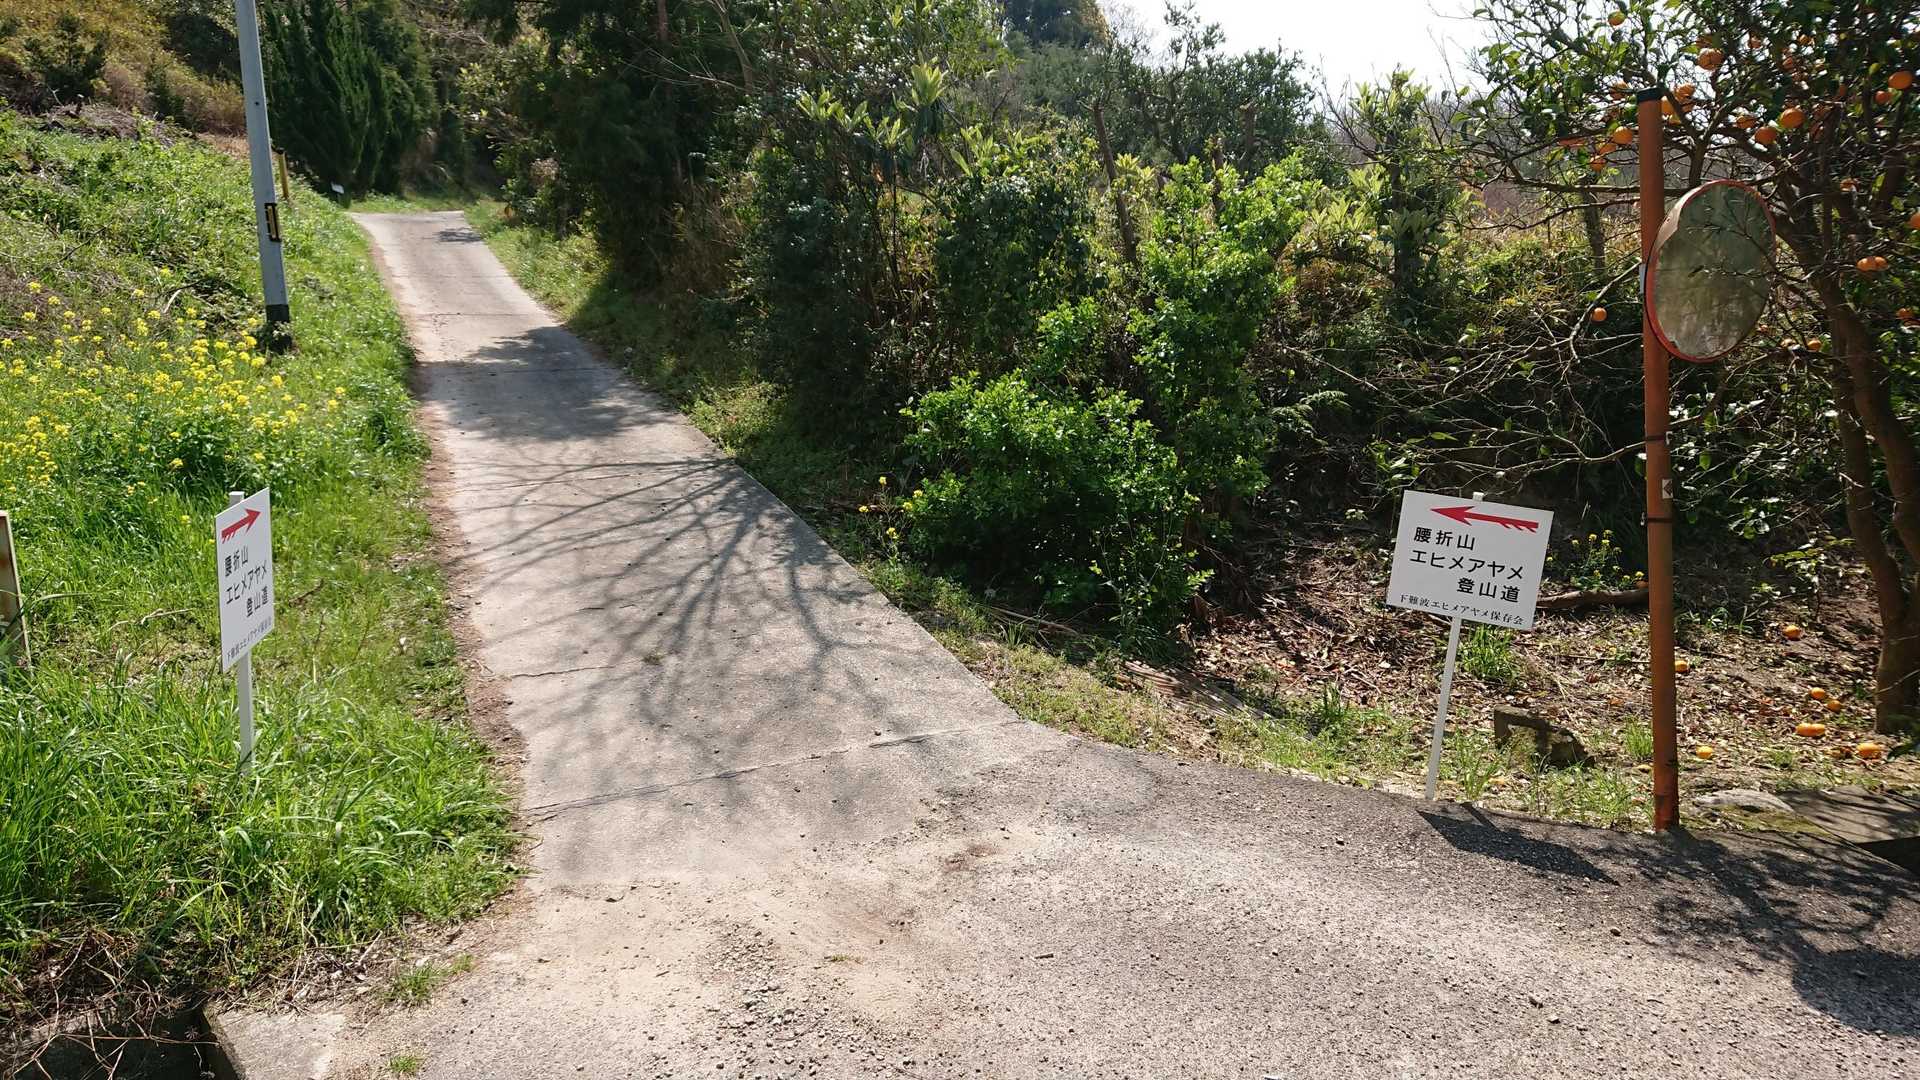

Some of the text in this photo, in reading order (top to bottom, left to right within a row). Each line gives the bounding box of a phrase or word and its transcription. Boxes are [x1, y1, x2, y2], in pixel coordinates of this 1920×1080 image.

[1413, 526, 1475, 551] 腰折山
[1409, 549, 1524, 580] エヒメアヤメ
[226, 560, 267, 605] エヒメアヤメ
[1456, 577, 1521, 603] 登山道
[1400, 594, 1524, 626] 下難波エヒメアヤメ保存会
